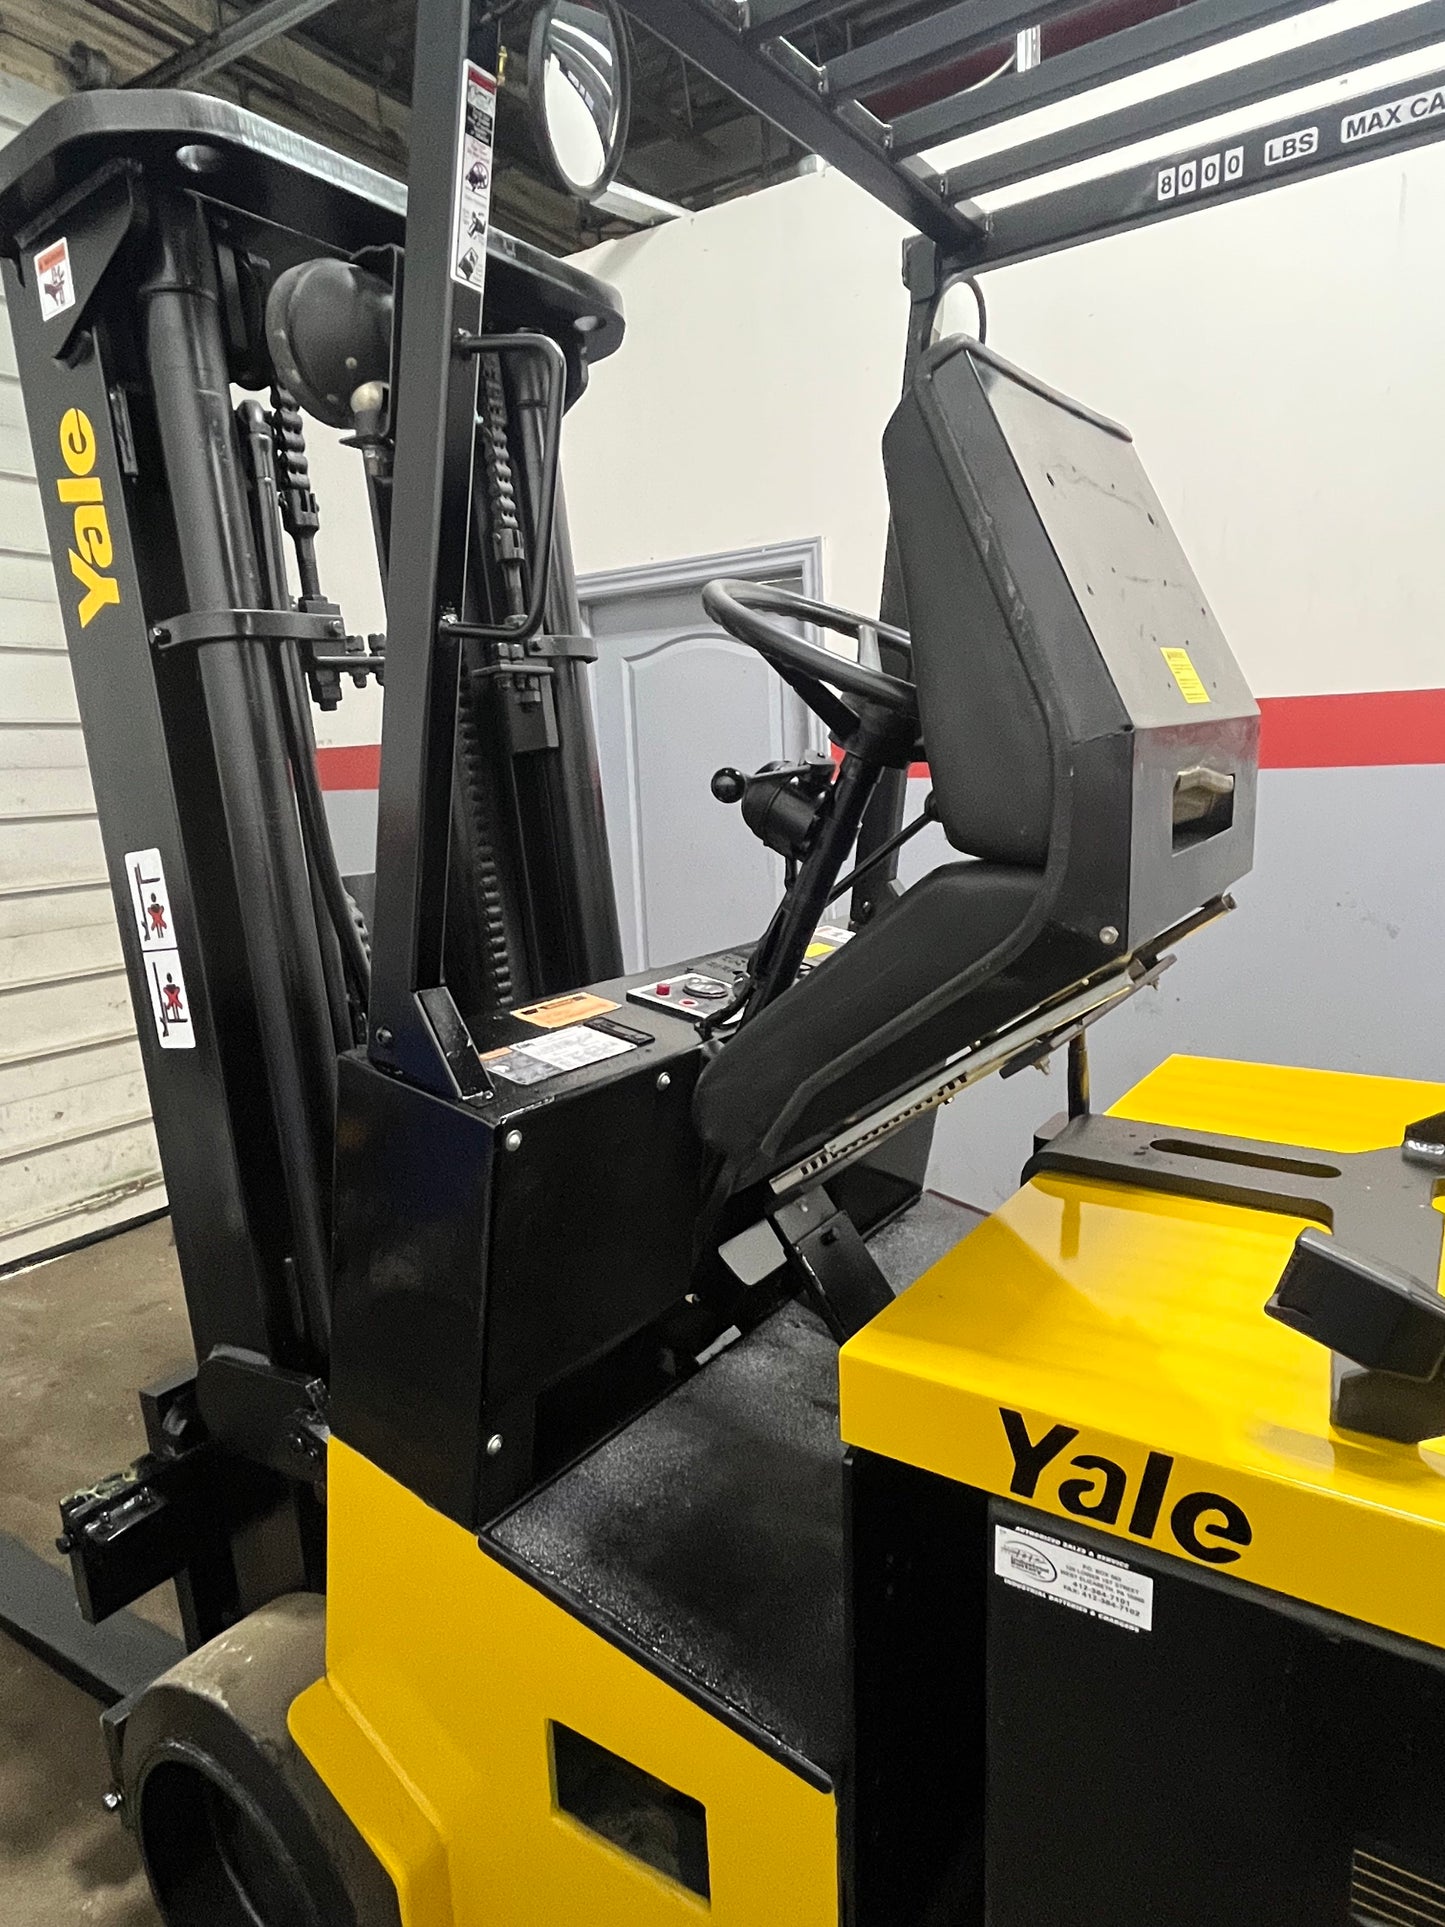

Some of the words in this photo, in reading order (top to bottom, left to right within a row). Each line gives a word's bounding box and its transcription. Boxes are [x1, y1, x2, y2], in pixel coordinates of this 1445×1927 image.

[1268, 133, 1314, 162] LBS
[1346, 105, 1401, 139] MAX
[57, 407, 121, 629] Yale
[998, 1406, 1253, 1564] Yale
